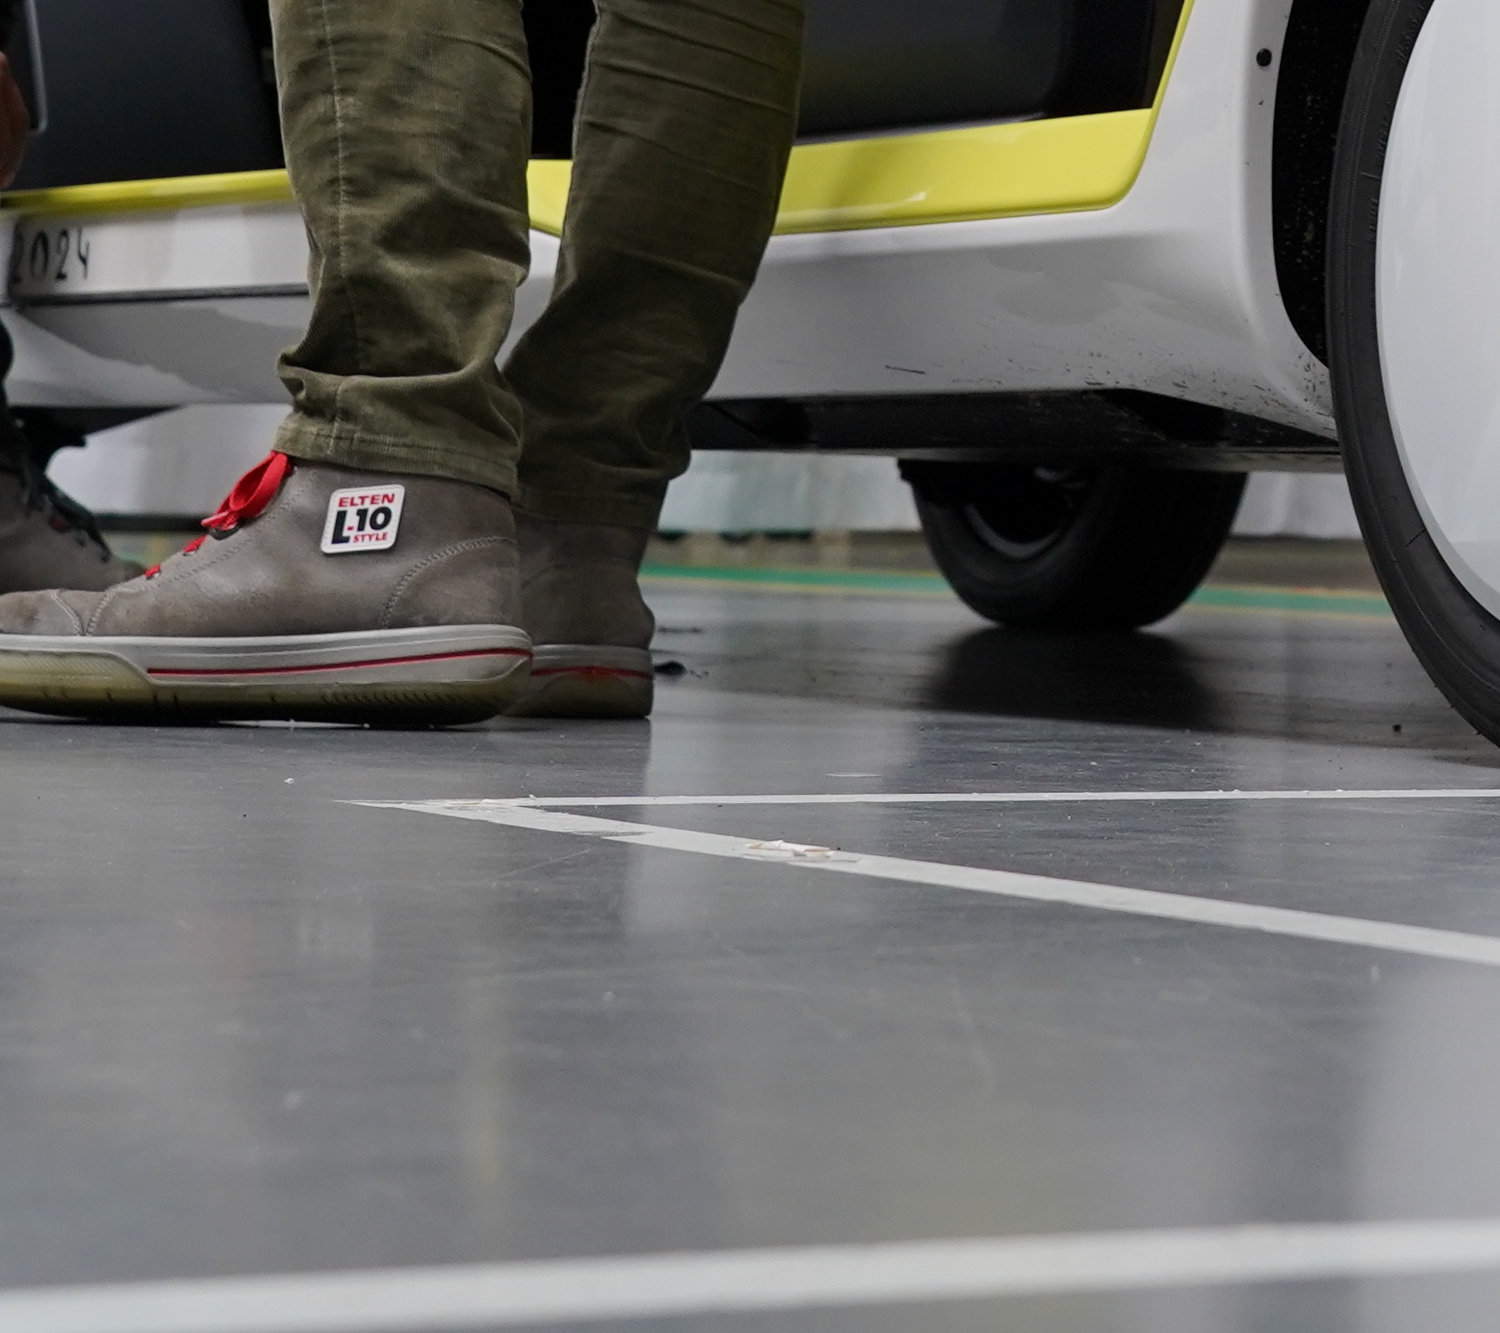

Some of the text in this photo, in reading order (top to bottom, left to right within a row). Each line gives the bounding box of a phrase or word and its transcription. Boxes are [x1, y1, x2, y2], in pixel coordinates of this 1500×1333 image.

[11, 225, 91, 285] 2024
[338, 493, 396, 508] ELTEN
[352, 532, 389, 544] STYLE
